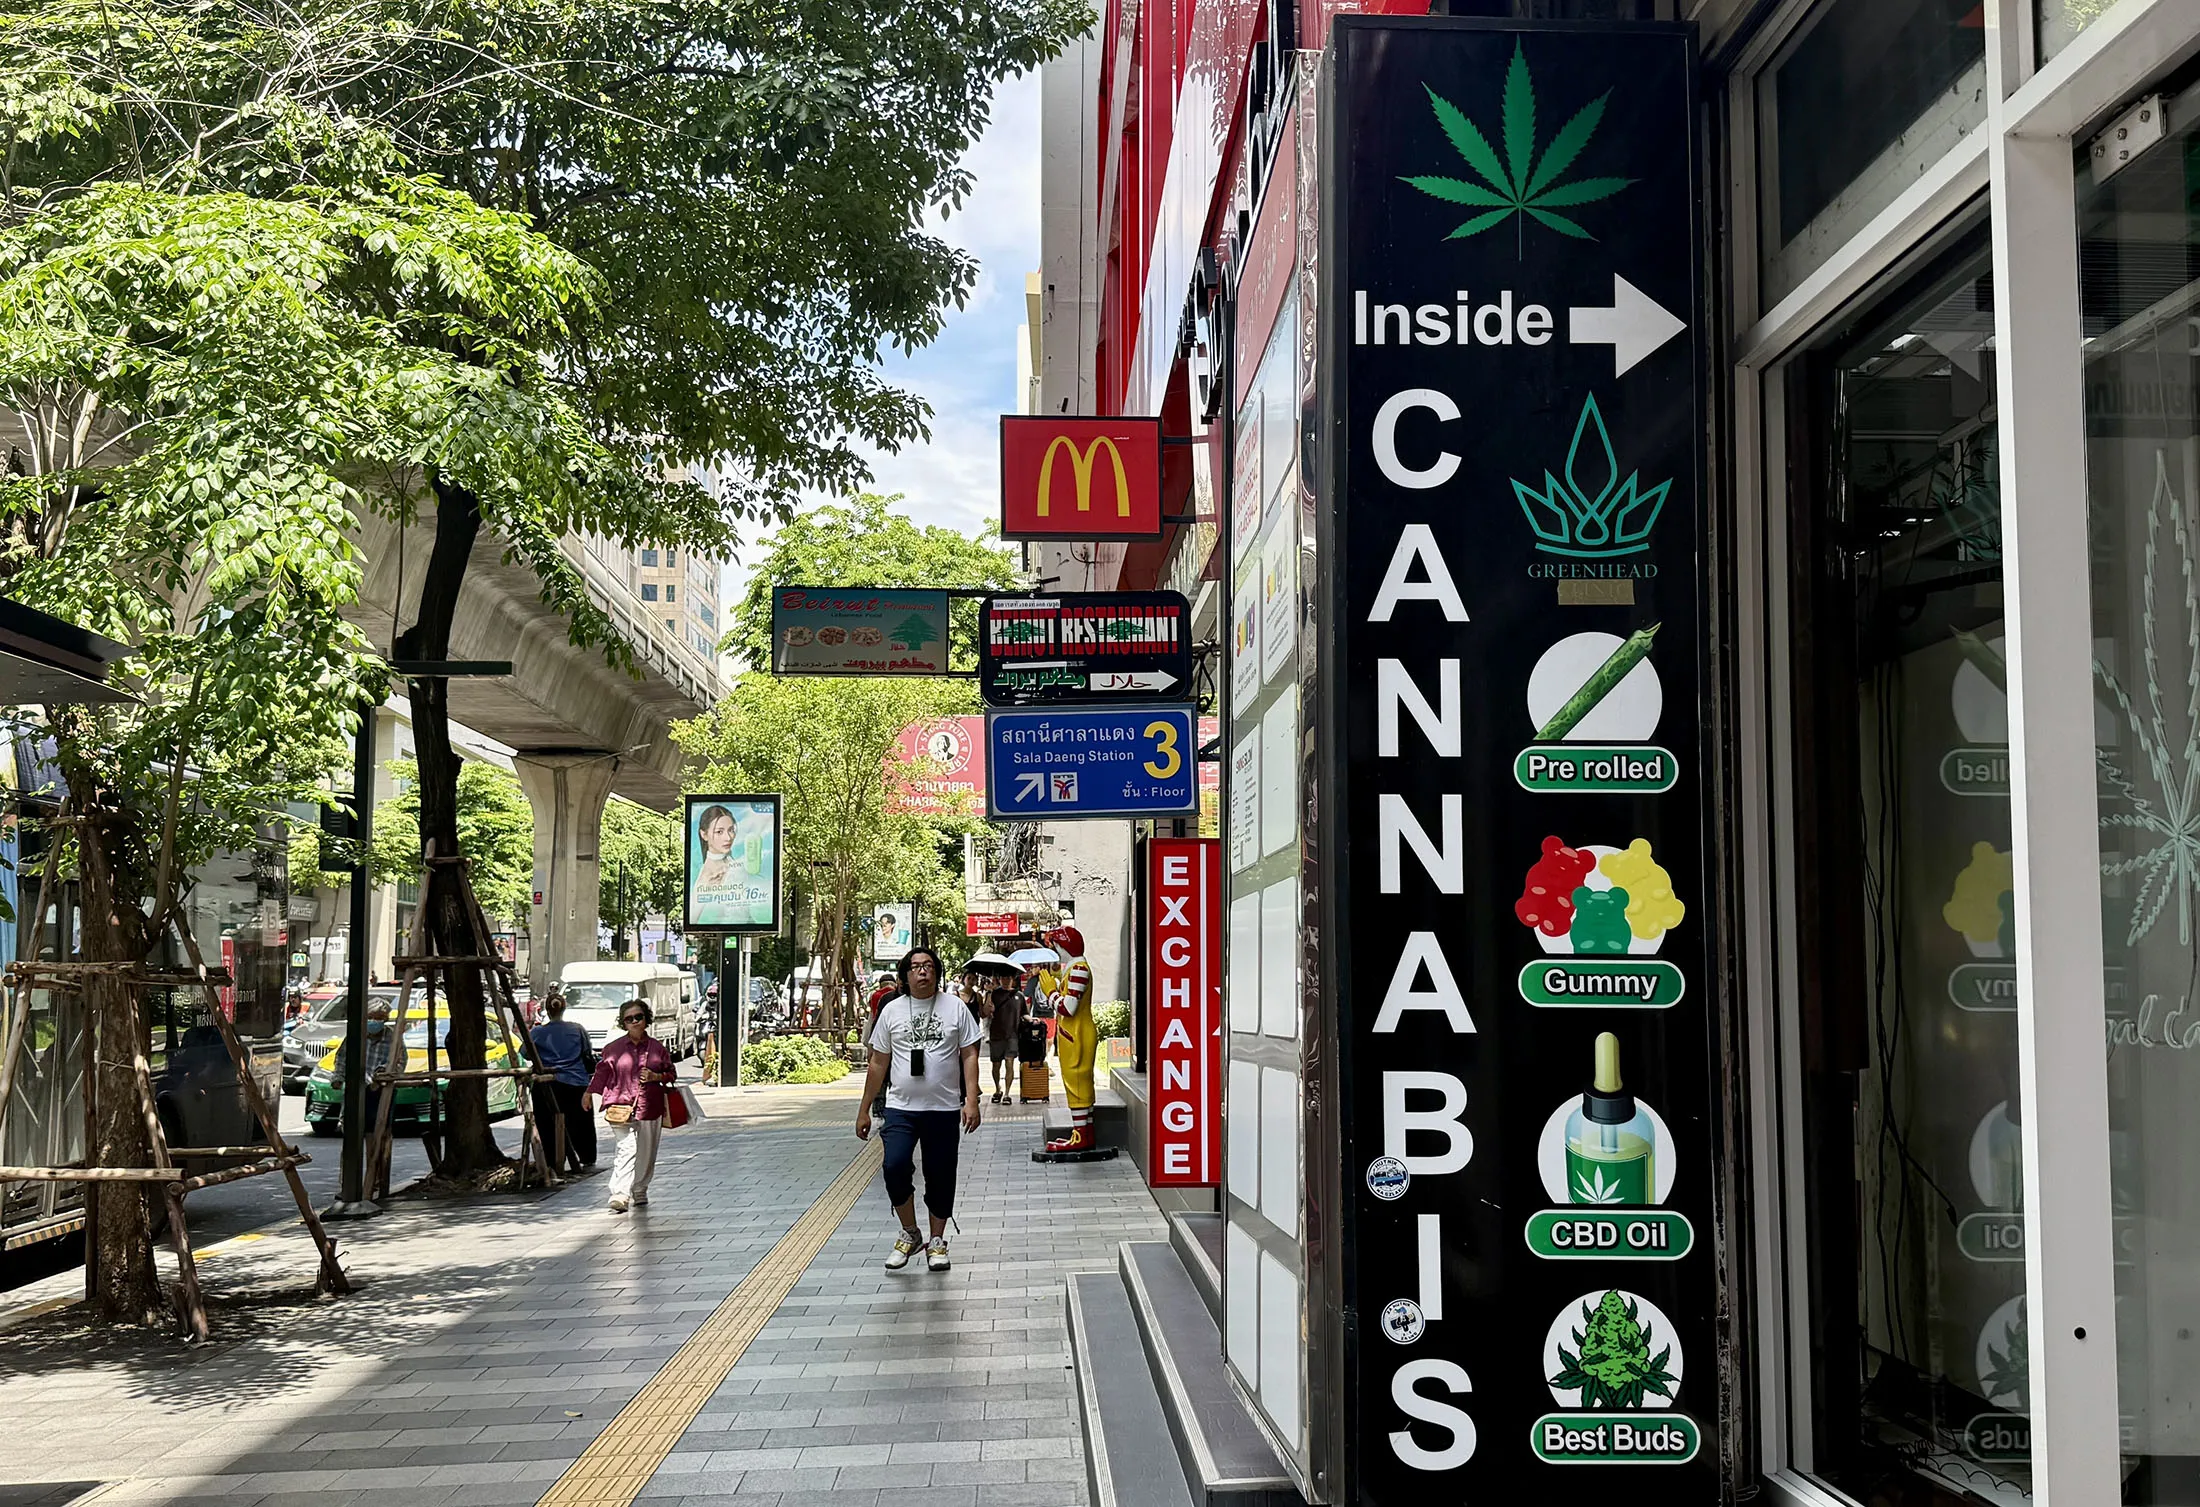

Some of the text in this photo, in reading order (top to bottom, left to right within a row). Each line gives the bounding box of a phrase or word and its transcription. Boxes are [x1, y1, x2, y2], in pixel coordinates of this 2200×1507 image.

[1355, 289, 1554, 346] Inside
[1527, 562, 1658, 580] GREENHEAD
[781, 591, 880, 611] Beirut
[989, 605, 1181, 657] BEIRUT RESTAURANT
[992, 666, 1087, 691] مطعم بيروت
[1100, 674, 1152, 690] حلال
[947, 722, 969, 743] PURE
[1002, 721, 1135, 744] สถานีศาลาแดง
[1013, 750, 1134, 765] Sala Daeng Station
[1143, 720, 1182, 780] 3
[1528, 754, 1662, 780] Pre rolled
[1122, 781, 1141, 798] ชั้น
[1151, 786, 1186, 797] Floor
[745, 887, 759, 900] 16
[1366, 388, 1478, 1471] CANNABIS
[1543, 968, 1658, 1000] Gummy
[1159, 855, 1194, 1175] EXCHANGE
[1550, 1220, 1667, 1248] CBD Oil
[1544, 1423, 1686, 1452] Best Buds
